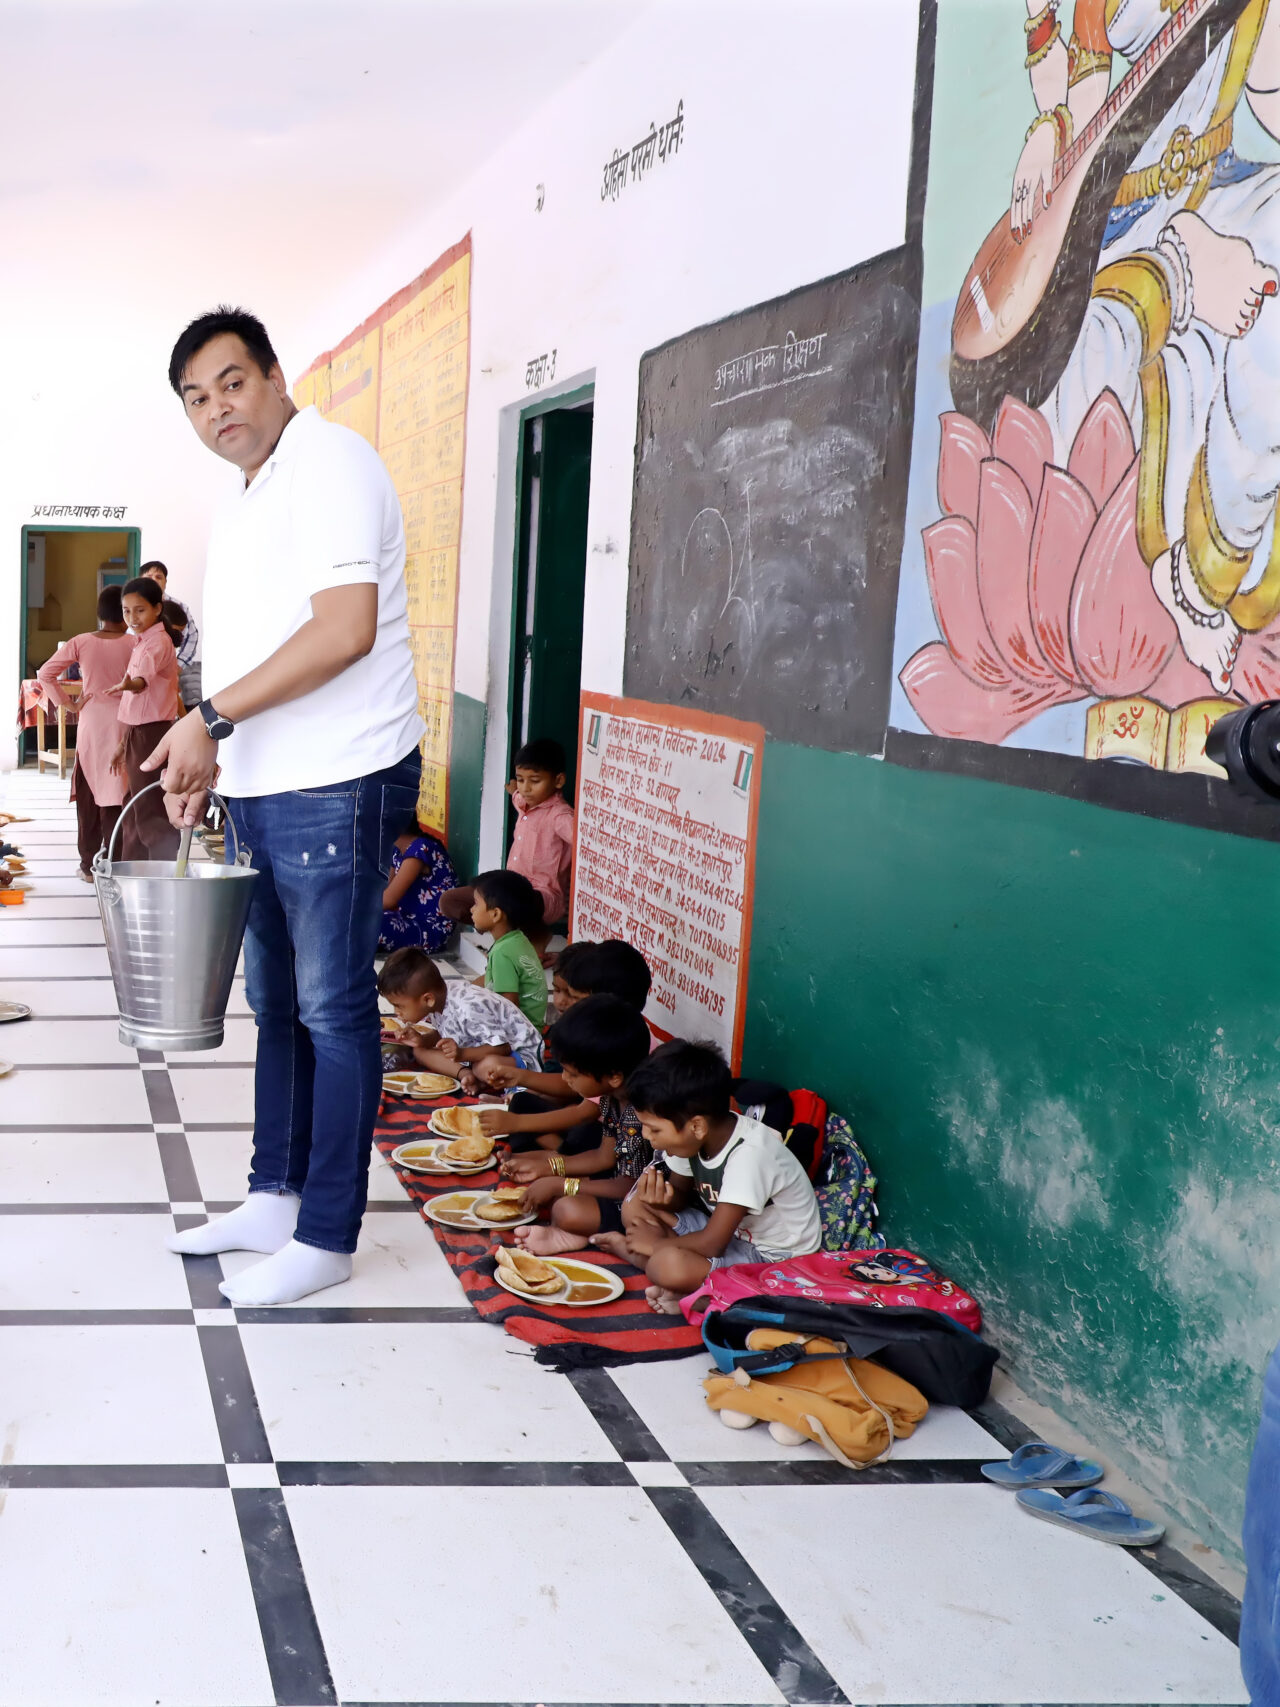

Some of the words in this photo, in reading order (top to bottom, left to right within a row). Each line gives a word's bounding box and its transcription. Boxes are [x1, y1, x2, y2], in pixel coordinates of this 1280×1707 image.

[601, 148, 630, 202] अहिंसा
[631, 121, 658, 182] परमो
[31, 505, 101, 519] प्रधानाध्यापक
[102, 505, 128, 521] कक्ष
[700, 738, 727, 764] 2024
[646, 779, 655, 796] 52
